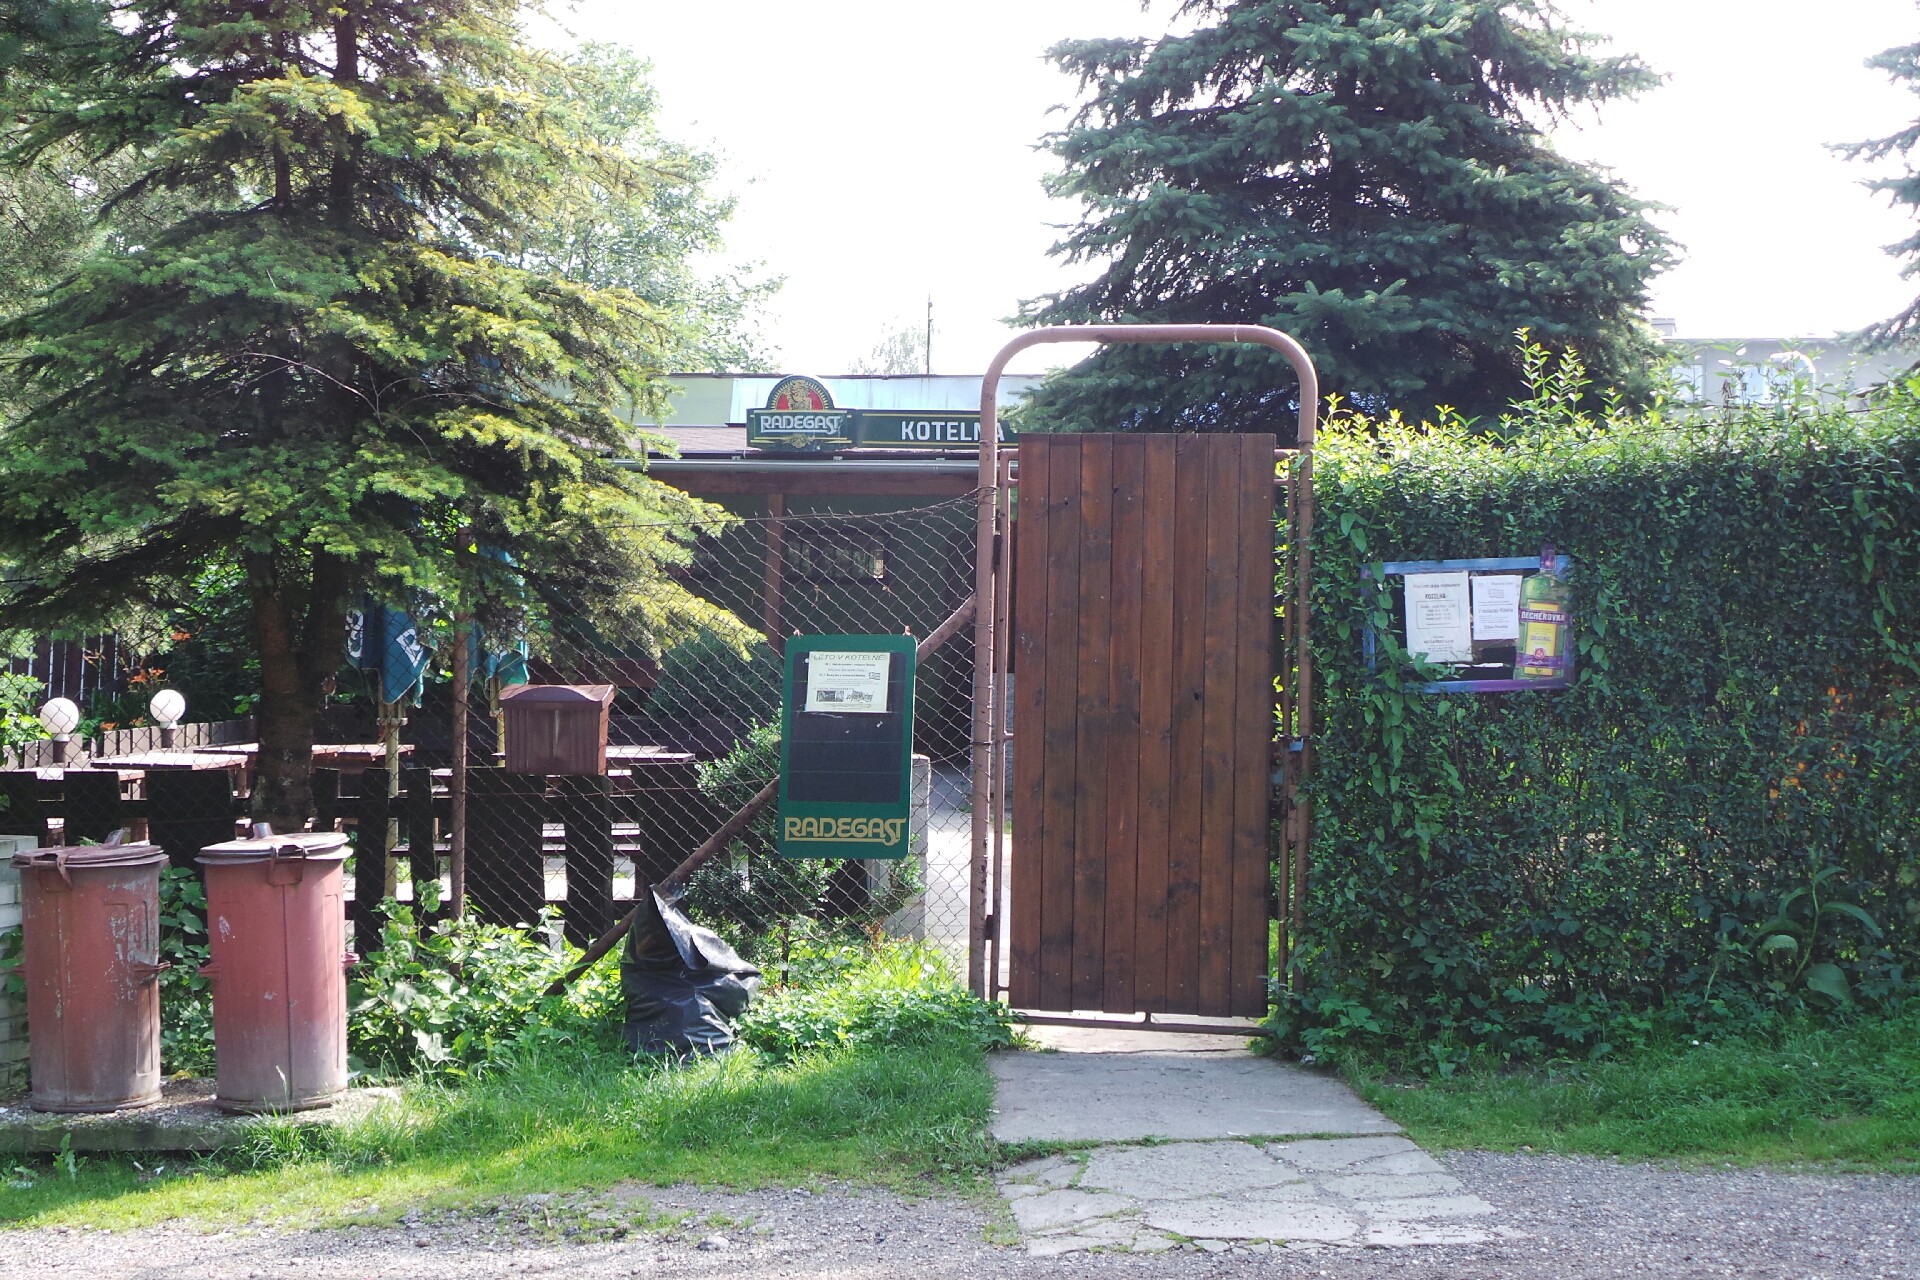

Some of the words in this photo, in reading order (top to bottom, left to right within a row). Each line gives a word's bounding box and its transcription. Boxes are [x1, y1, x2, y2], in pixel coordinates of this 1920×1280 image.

[760, 415, 843, 434] RADEGAST
[1521, 611, 1565, 622] BECHEROVKA
[784, 816, 907, 846] RADEGAST
